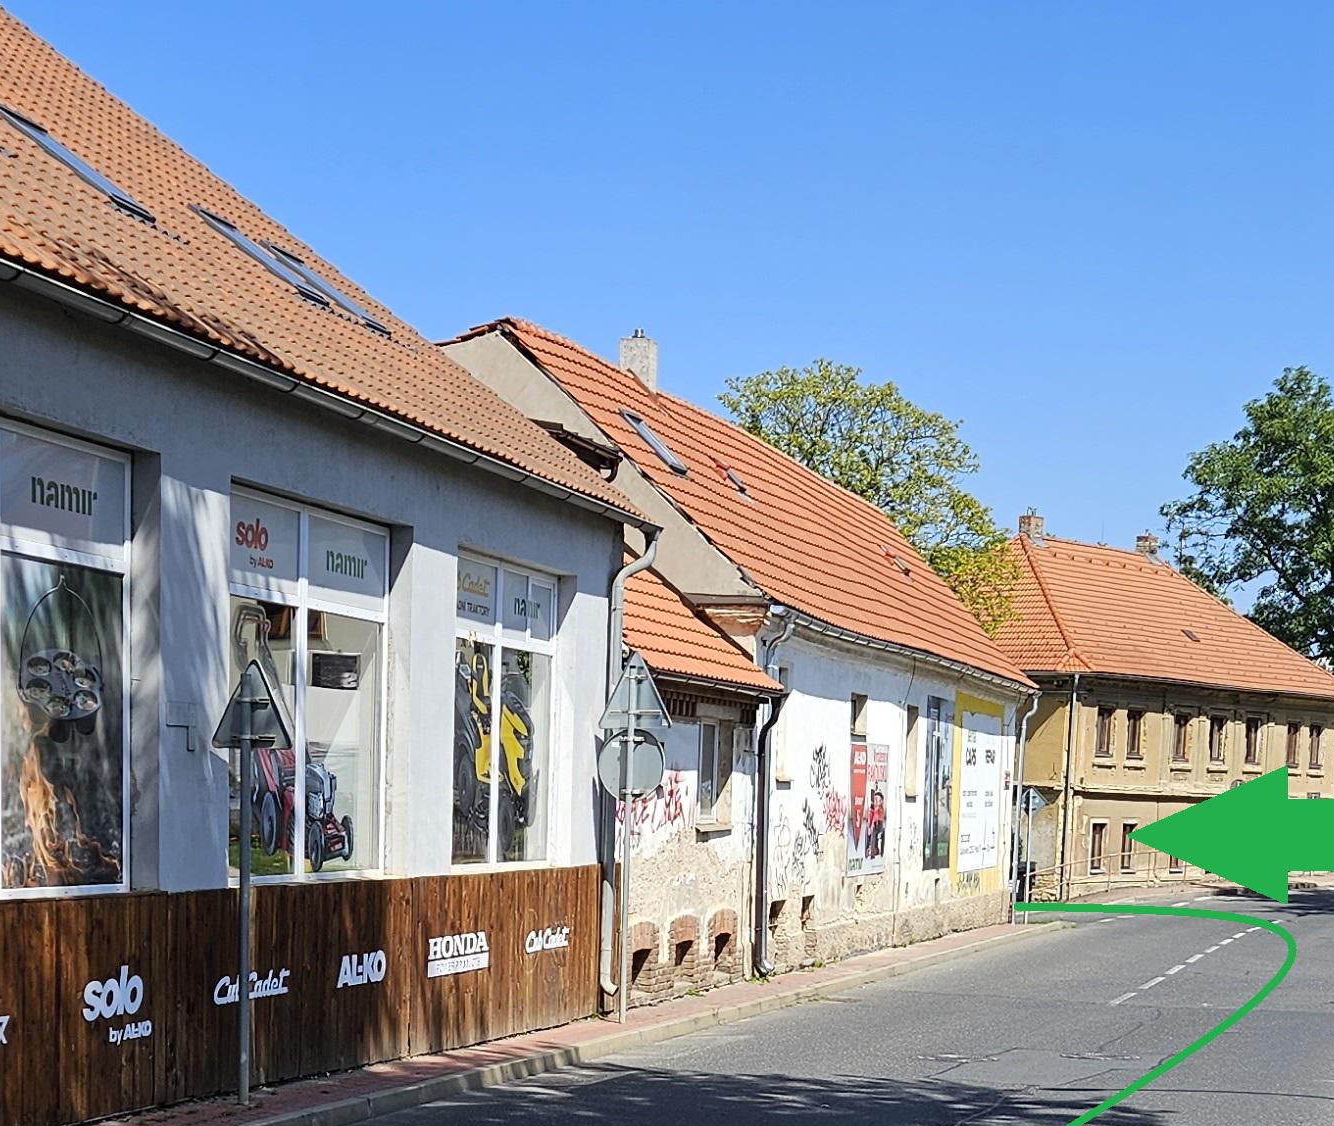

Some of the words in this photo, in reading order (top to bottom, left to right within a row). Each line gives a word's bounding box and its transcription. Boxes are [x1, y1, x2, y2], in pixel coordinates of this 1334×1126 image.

[30, 475, 98, 516] namir
[235, 518, 269, 551] solo
[326, 549, 368, 579] namir
[428, 931, 489, 960] HONDA
[336, 949, 387, 988] AL-KO
[82, 964, 144, 1022] solo
[109, 1027, 124, 1046] by
[123, 1019, 152, 1040] AL-KO
